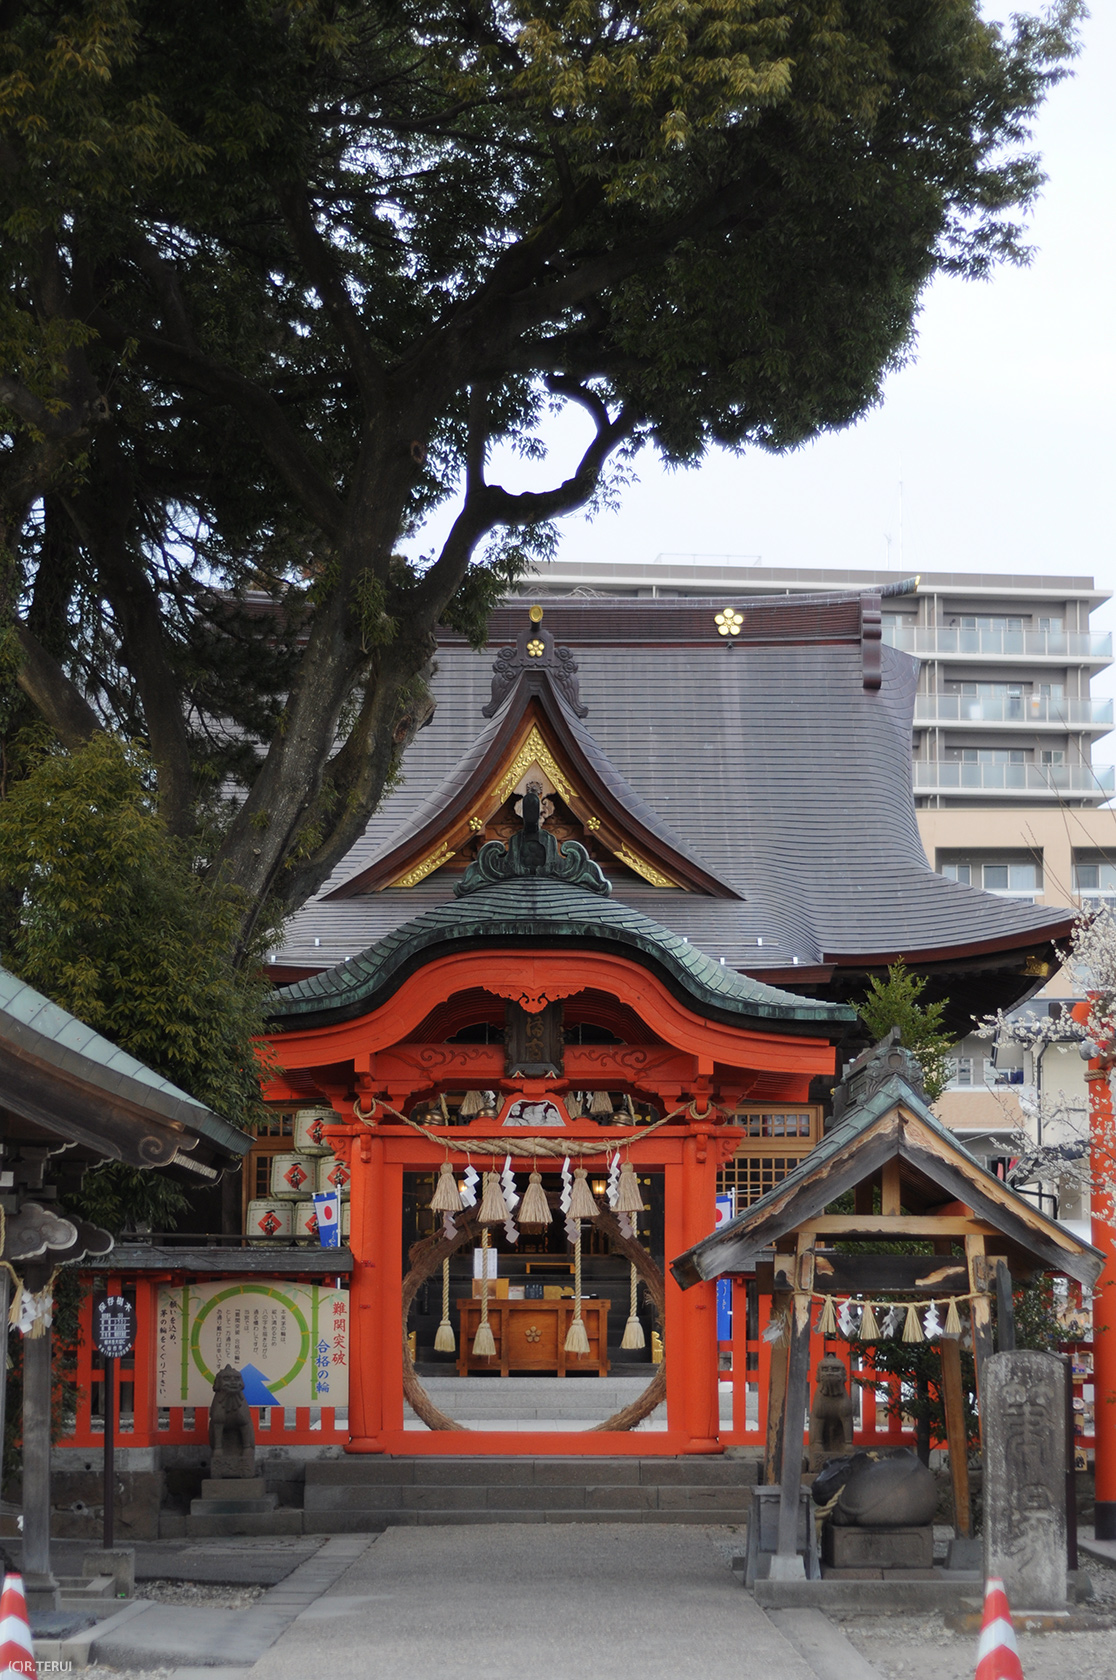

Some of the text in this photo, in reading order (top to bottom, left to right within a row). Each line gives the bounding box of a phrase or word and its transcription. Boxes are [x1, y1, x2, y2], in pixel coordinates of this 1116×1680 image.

[168, 1300, 178, 1344] 願いを込め、
[332, 1301, 347, 1366] 難関突破
[315, 1339, 331, 1393] 合格の輪
